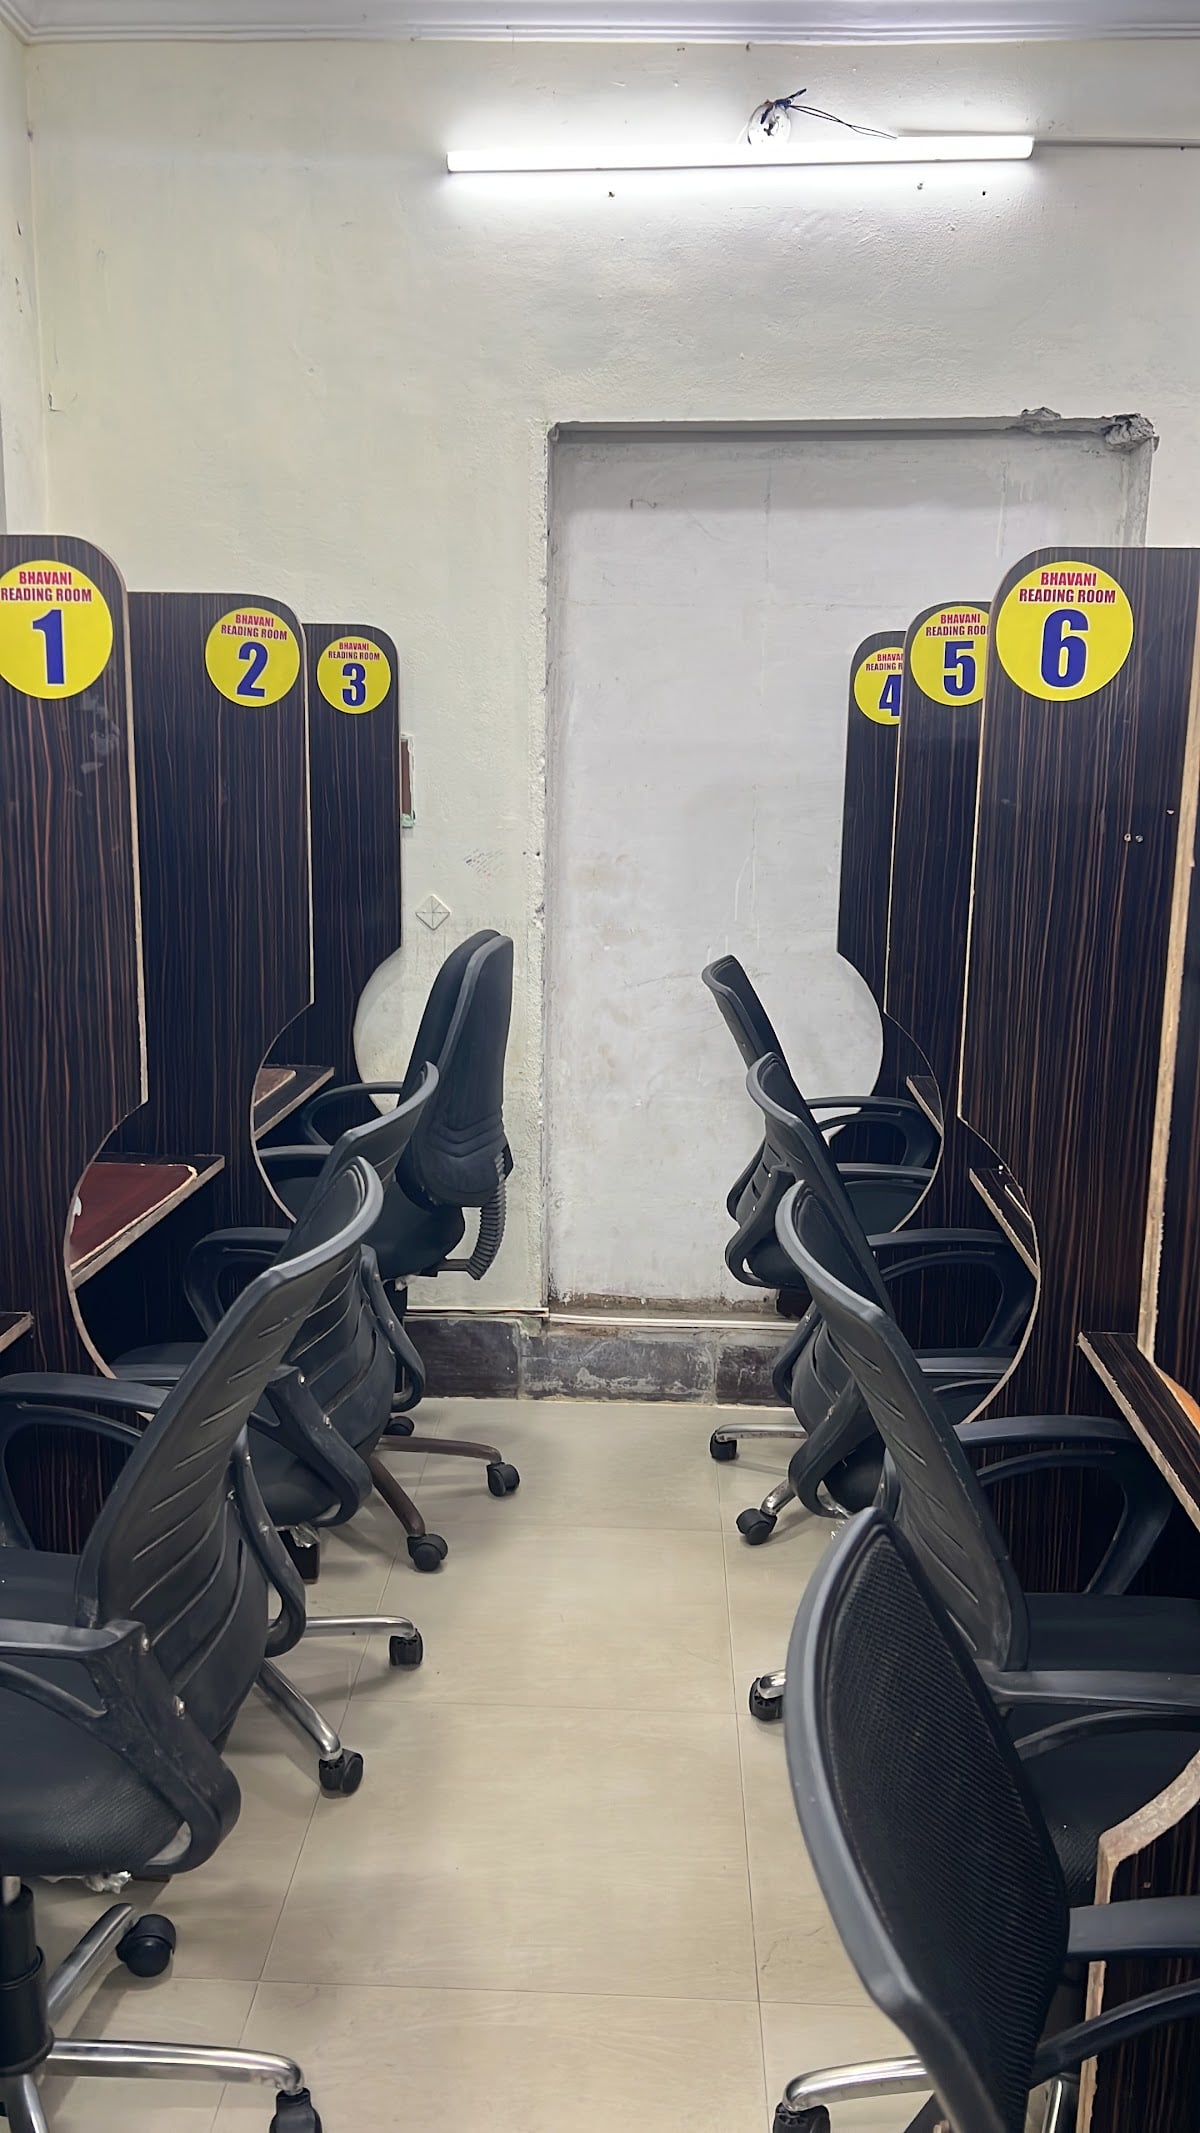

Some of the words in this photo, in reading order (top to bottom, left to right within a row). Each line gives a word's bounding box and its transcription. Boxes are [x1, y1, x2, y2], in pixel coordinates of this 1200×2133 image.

[19, 571, 72, 585] BHAVANI
[1041, 572, 1097, 586] BHAVANI
[0, 588, 53, 601] READING
[56, 588, 92, 602] ROOM
[1019, 588, 1074, 602] READING
[1077, 590, 1116, 603] ROOM
[235, 614, 274, 627] BHAVANI
[940, 613, 981, 624] BHAVANI
[221, 624, 259, 637] READING
[261, 628, 287, 640] ROOM
[925, 626, 965, 636] READING
[967, 625, 988, 635] ROO
[32, 609, 65, 685] 1
[339, 641, 369, 651] BHAVANI
[1041, 608, 1089, 688] 6
[328, 650, 358, 660] READING
[359, 651, 380, 661] ROOM
[877, 653, 904, 662] BHAVA
[236, 641, 268, 697] 2
[865, 663, 897, 671] READING
[943, 640, 976, 697] 5
[342, 662, 366, 707] 3
[879, 674, 902, 717] 4
